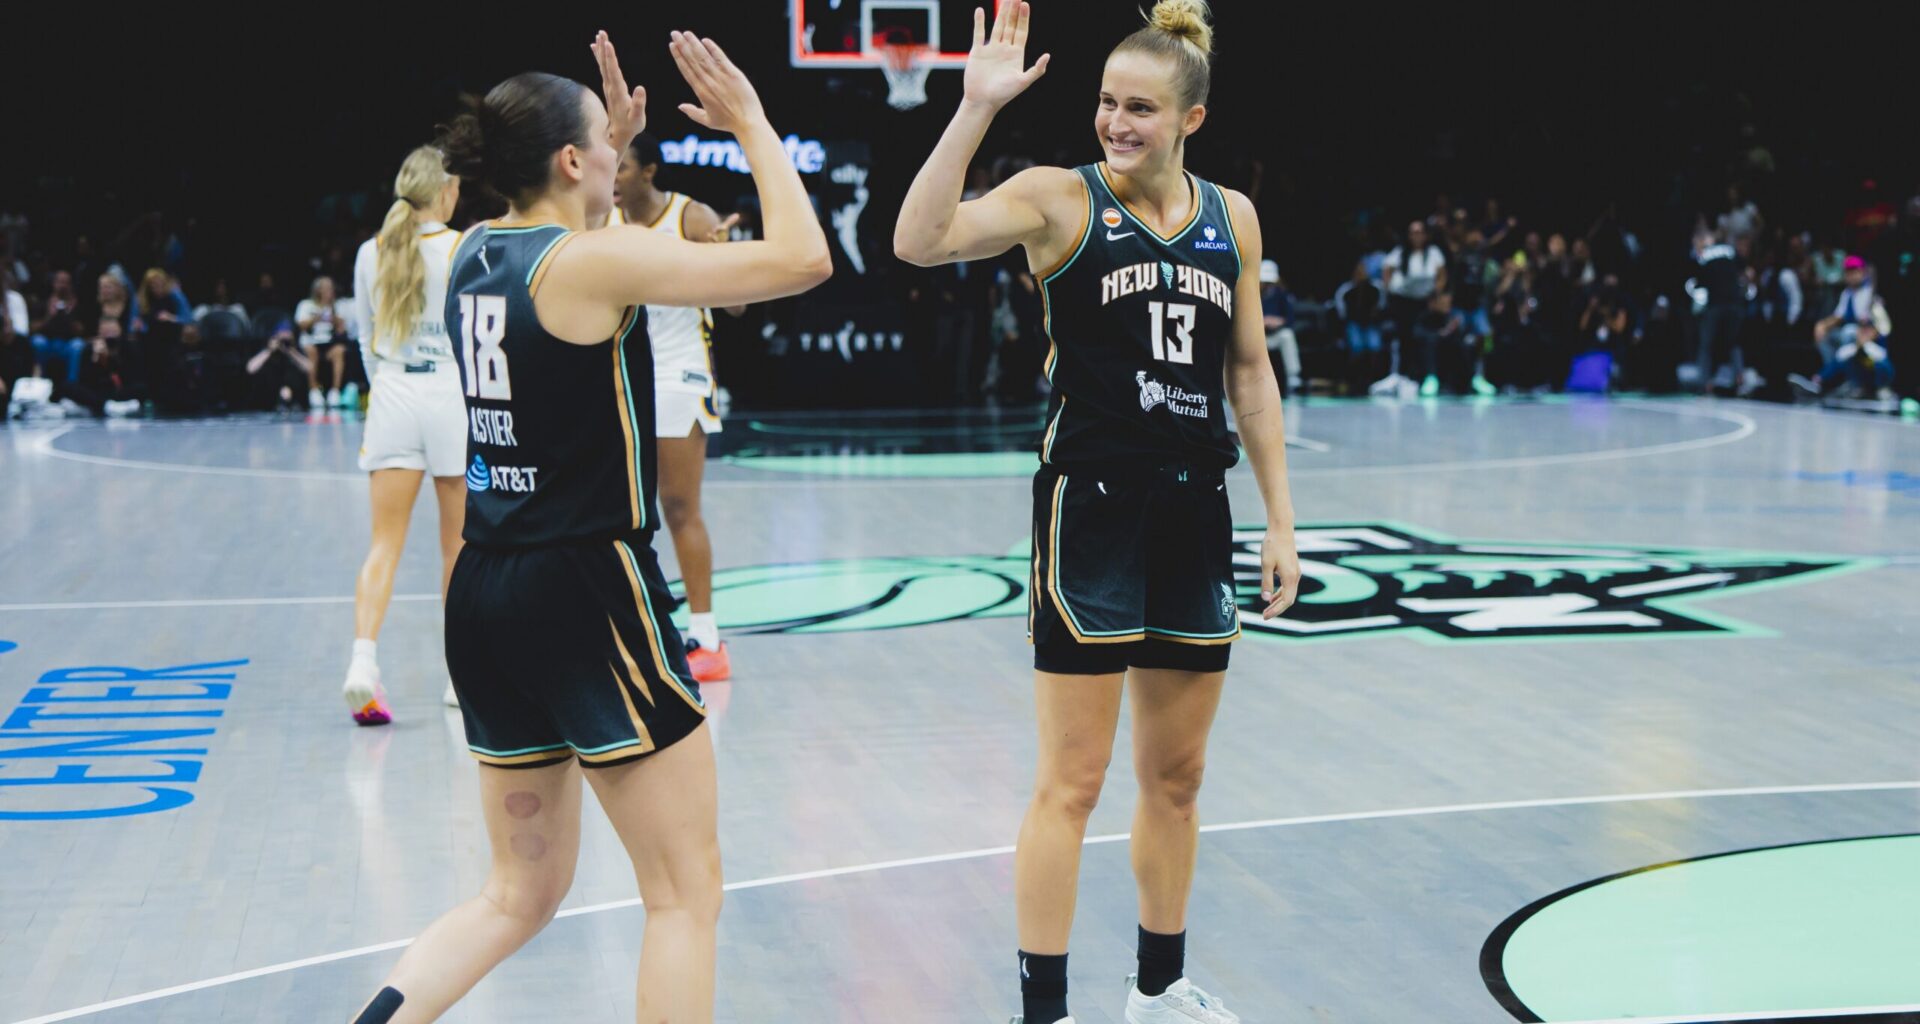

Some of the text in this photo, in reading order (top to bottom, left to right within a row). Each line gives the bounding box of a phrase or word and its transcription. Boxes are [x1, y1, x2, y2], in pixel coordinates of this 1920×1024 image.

[1195, 242, 1228, 250] BARCLAYS
[1101, 262, 1232, 320] NEW YORK
[458, 294, 512, 400] 18
[1148, 301, 1197, 365] 13
[1166, 385, 1208, 405] Liberty
[1166, 399, 1208, 418] Mutual
[471, 406, 518, 447] ASTIER
[490, 466, 538, 492] AT&T
[0, 658, 250, 821] CENTER
